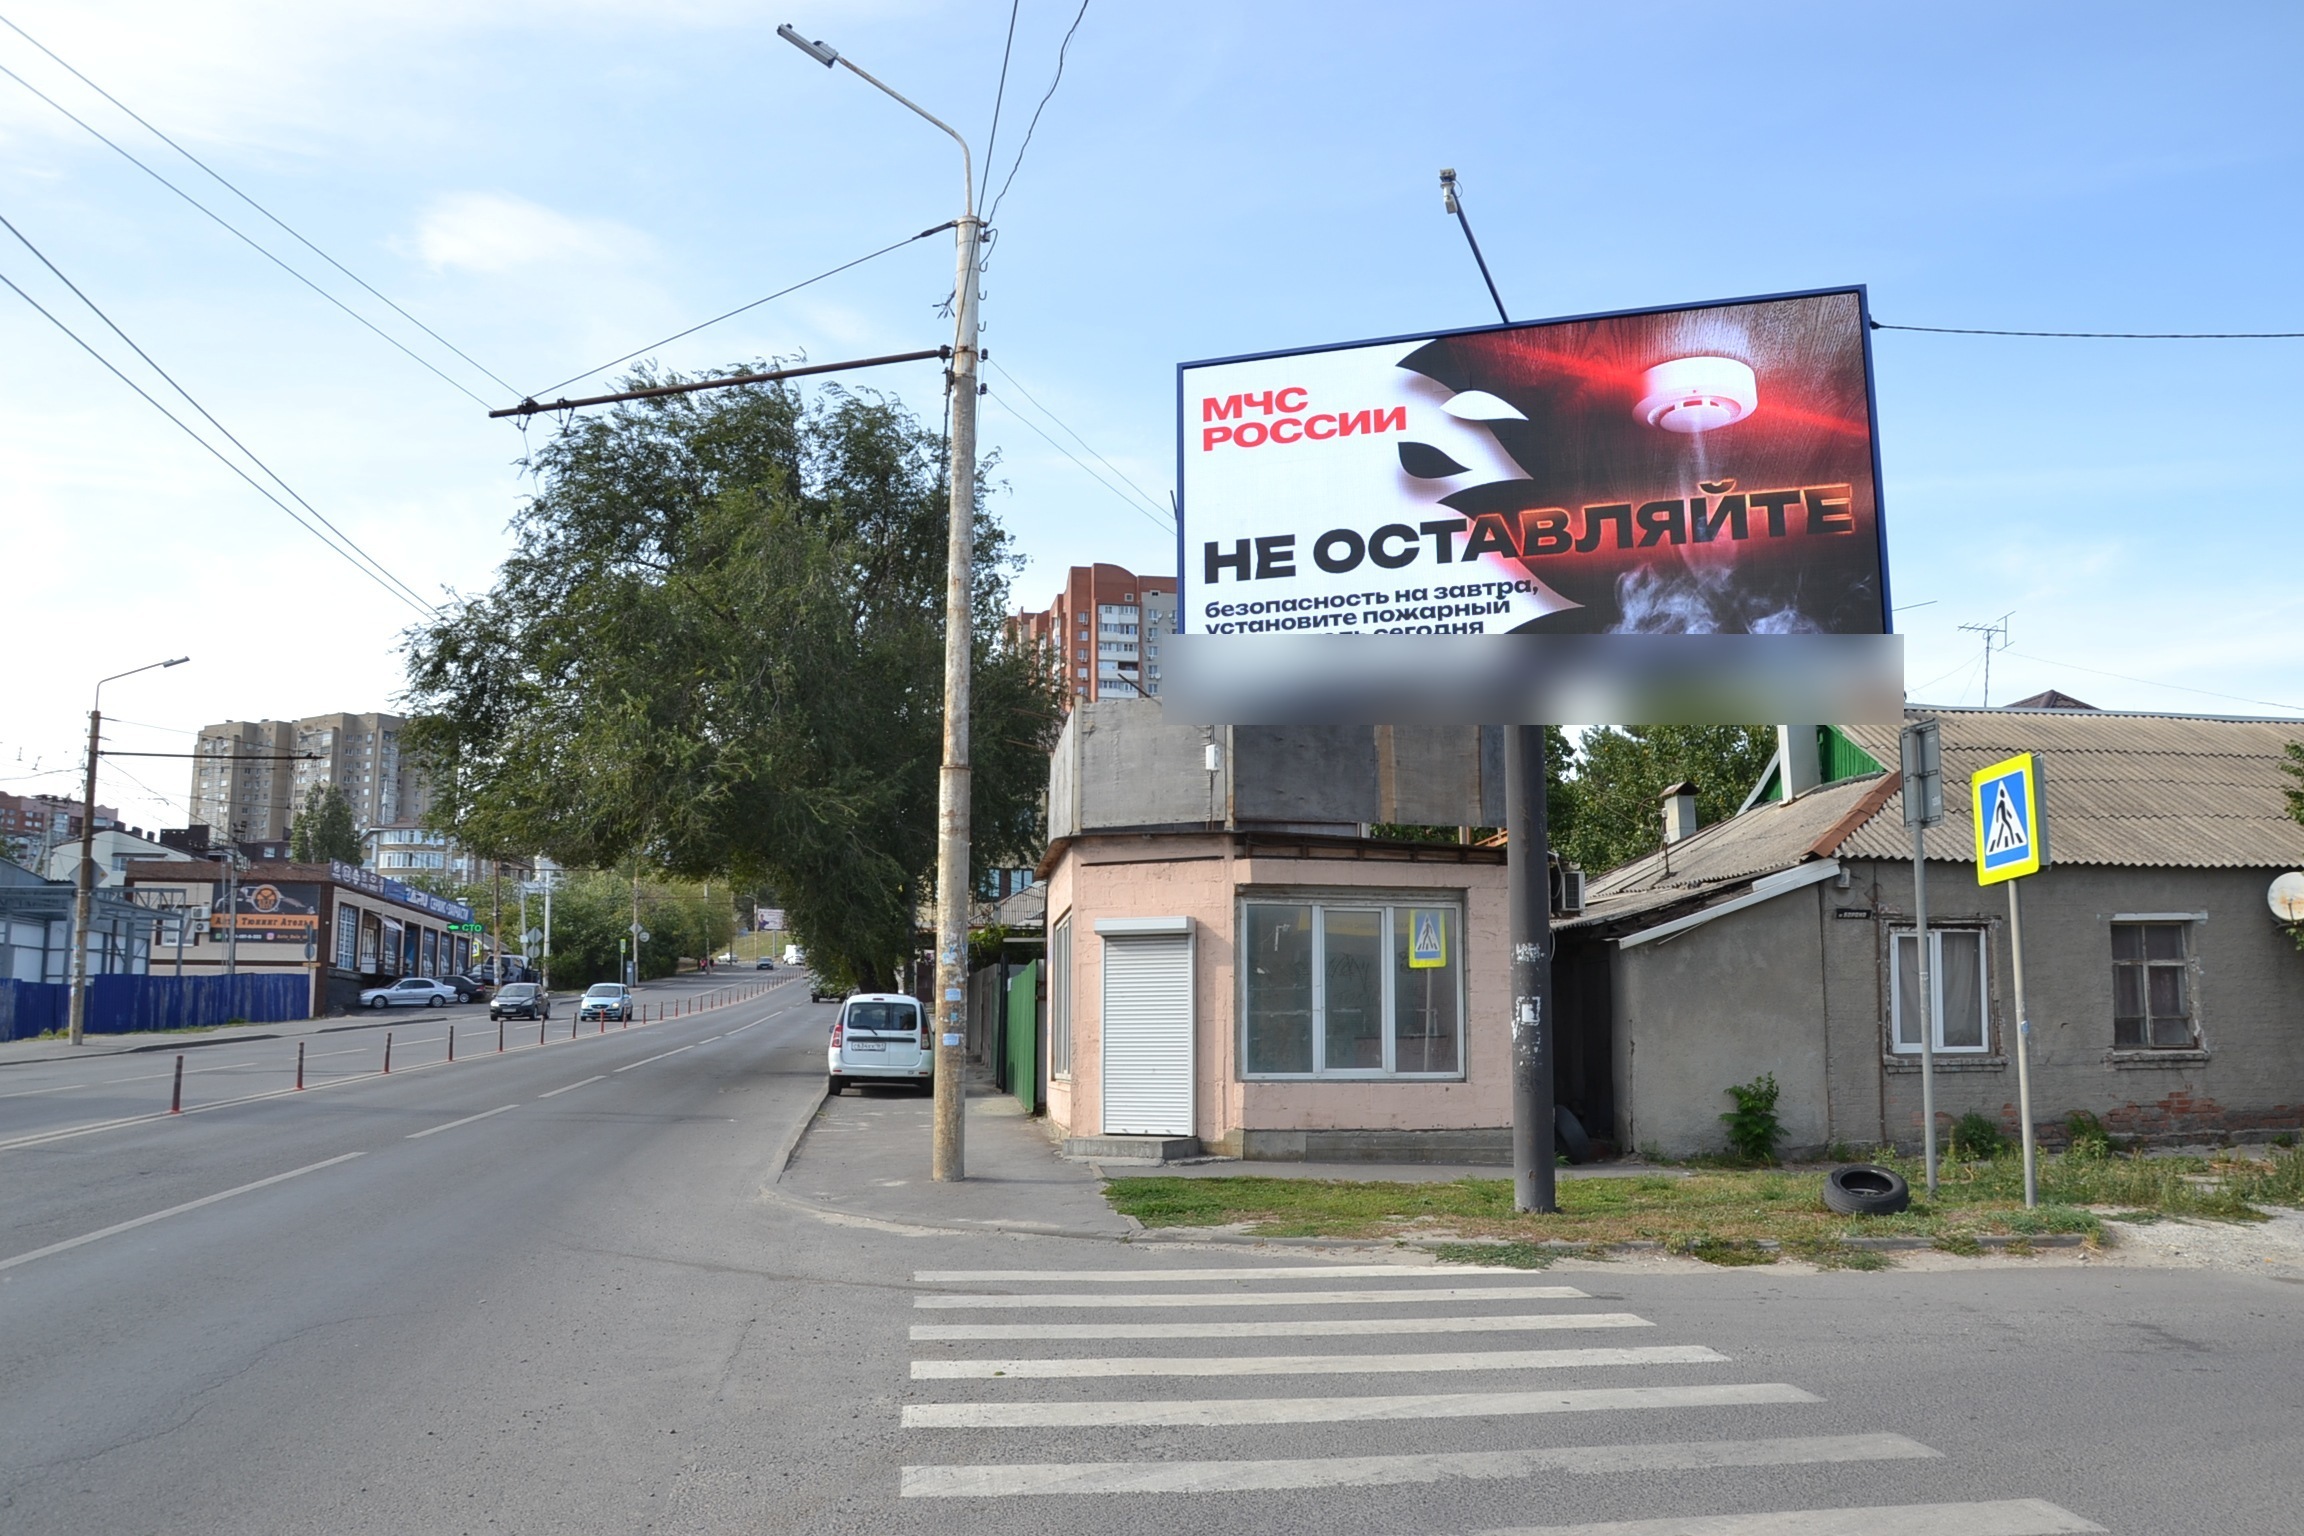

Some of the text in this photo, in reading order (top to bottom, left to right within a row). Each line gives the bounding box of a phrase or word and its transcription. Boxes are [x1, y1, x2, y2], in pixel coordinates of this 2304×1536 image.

[1203, 387, 1308, 422] МЧС
[1203, 406, 1406, 451] РОССИИ
[1204, 479, 1854, 585] НЕ ОСТАВЛЯЙТЕ
[1205, 580, 1538, 618] безопасность на завтра,
[1205, 594, 1510, 634] установите пожарный
[461, 924, 482, 932] СТО
